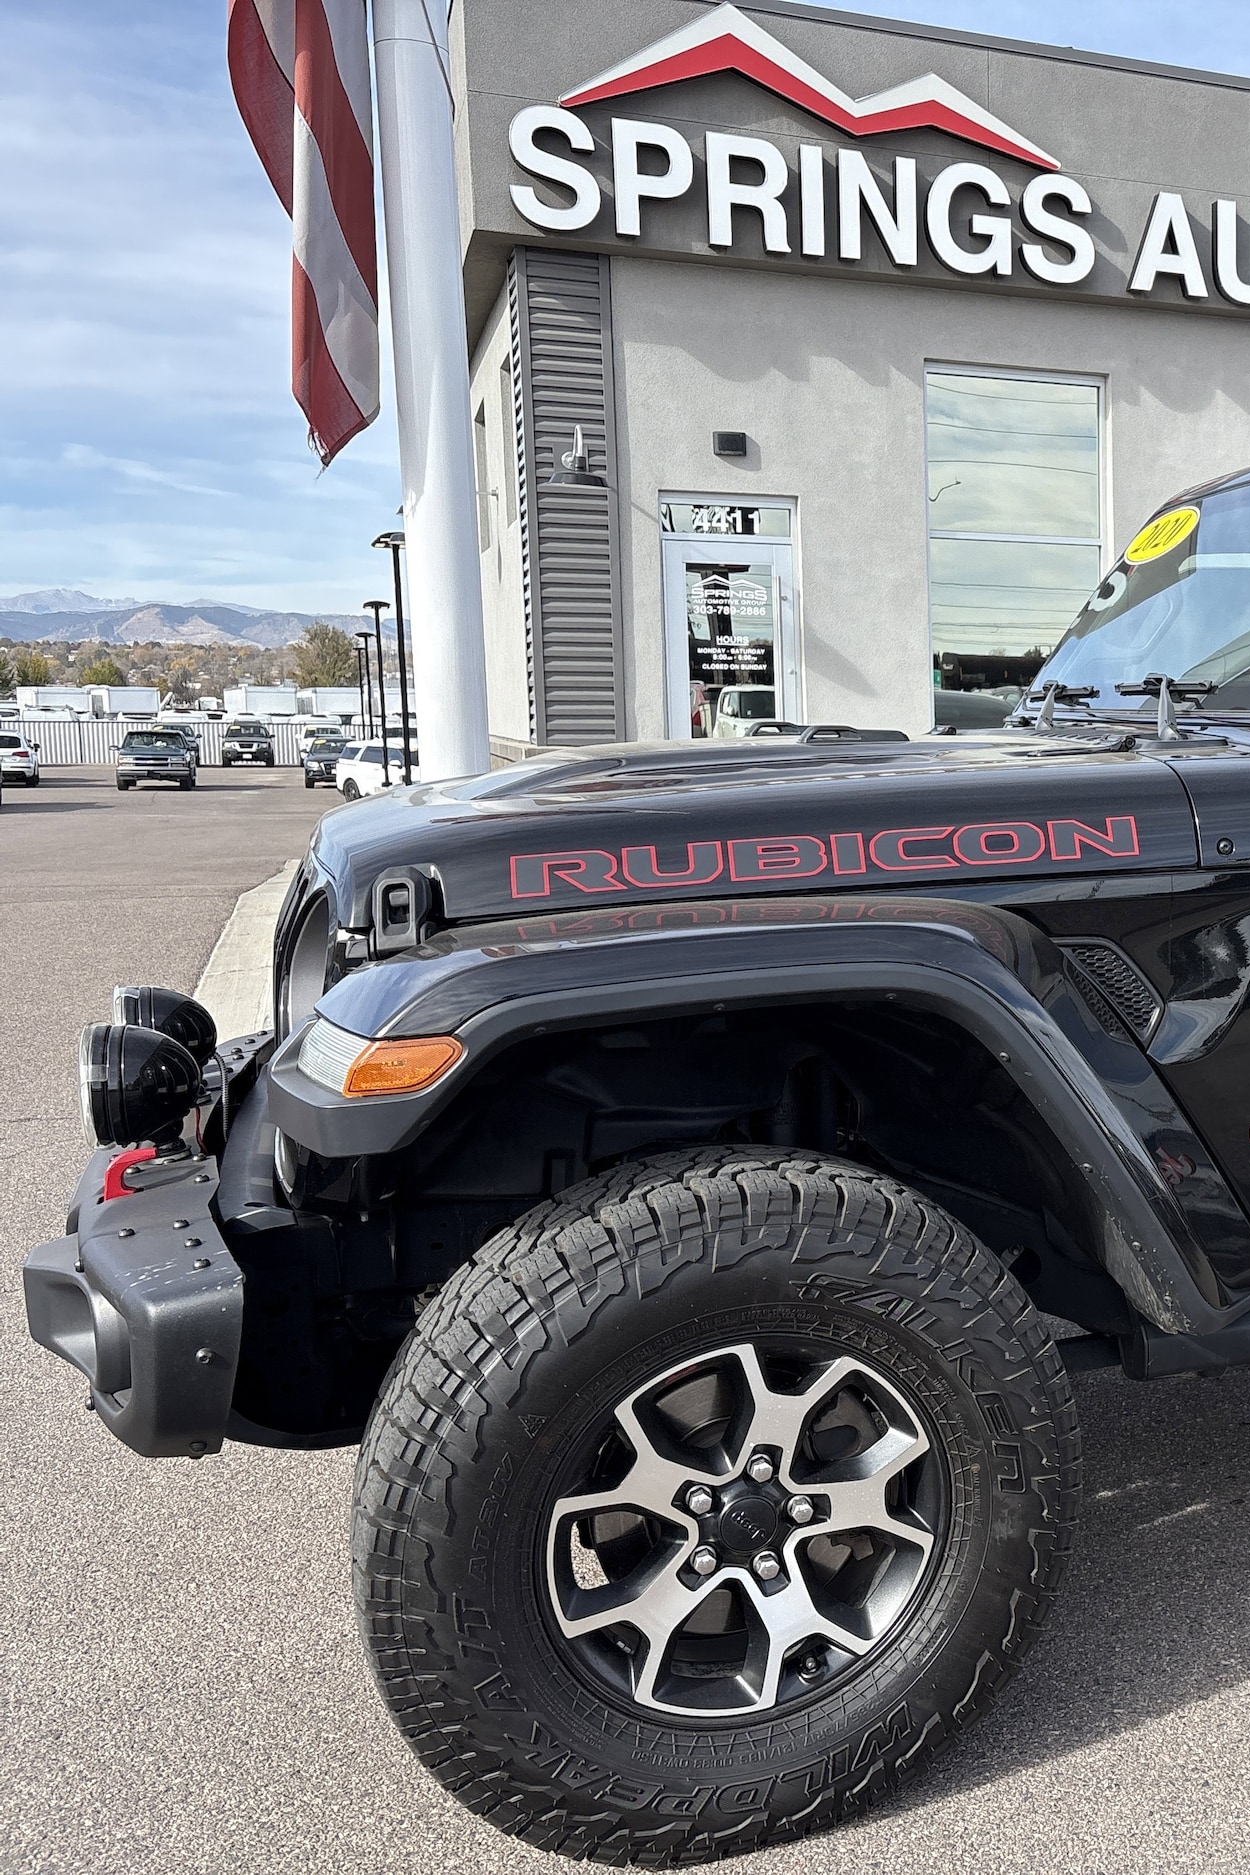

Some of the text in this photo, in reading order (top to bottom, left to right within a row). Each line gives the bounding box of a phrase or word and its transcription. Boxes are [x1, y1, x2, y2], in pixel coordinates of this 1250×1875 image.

[508, 105, 1096, 284] SPRINGS
[693, 506, 760, 534] 4411
[1131, 513, 1192, 554] 2020
[691, 588, 767, 601] SPRINGS
[716, 635, 749, 644] HOURS
[702, 662, 729, 670] CLOSED
[509, 815, 1141, 899] RUBICON
